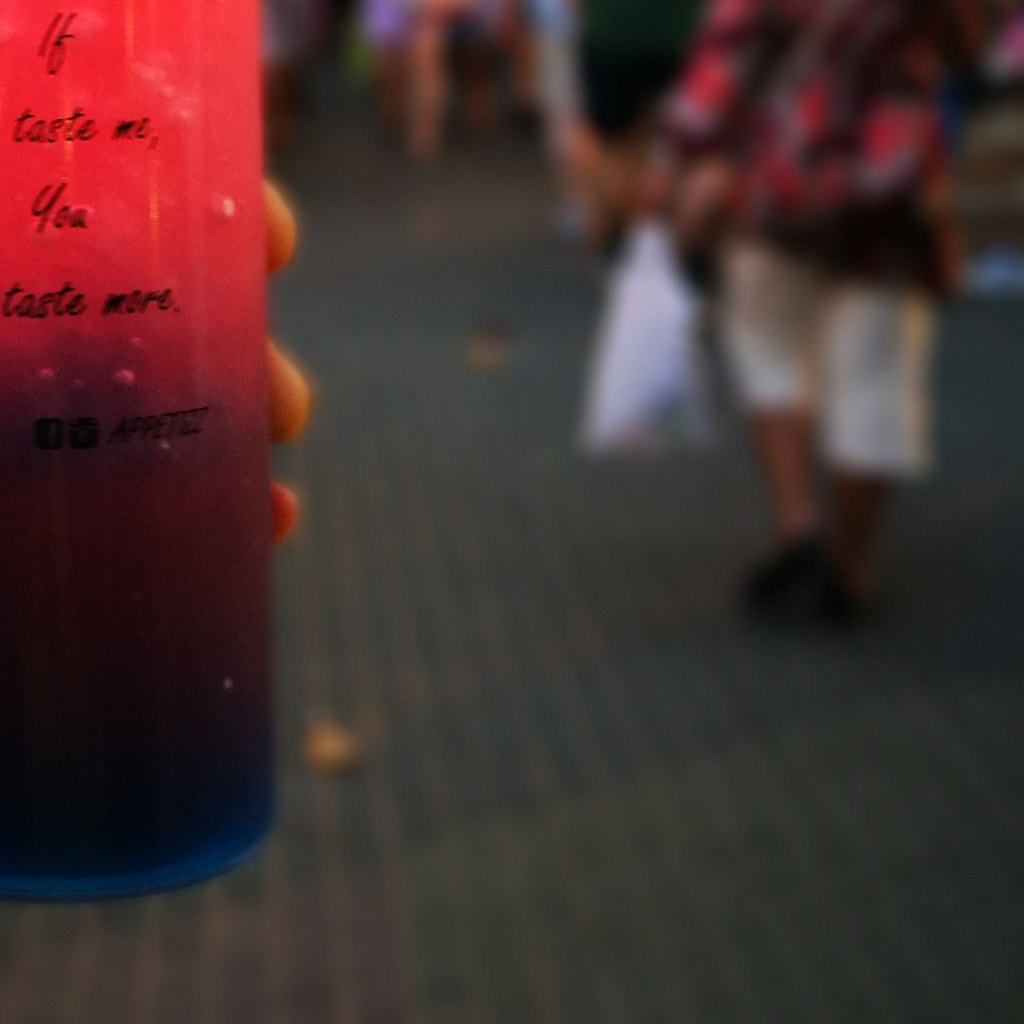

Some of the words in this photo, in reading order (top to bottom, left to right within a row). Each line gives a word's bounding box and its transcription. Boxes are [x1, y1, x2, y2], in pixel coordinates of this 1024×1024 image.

[37, 12, 77, 75] If
[12, 108, 97, 143] taste
[112, 117, 159, 150] me,
[32, 182, 88, 233] You
[1, 282, 85, 318] taste
[102, 288, 181, 316] more.
